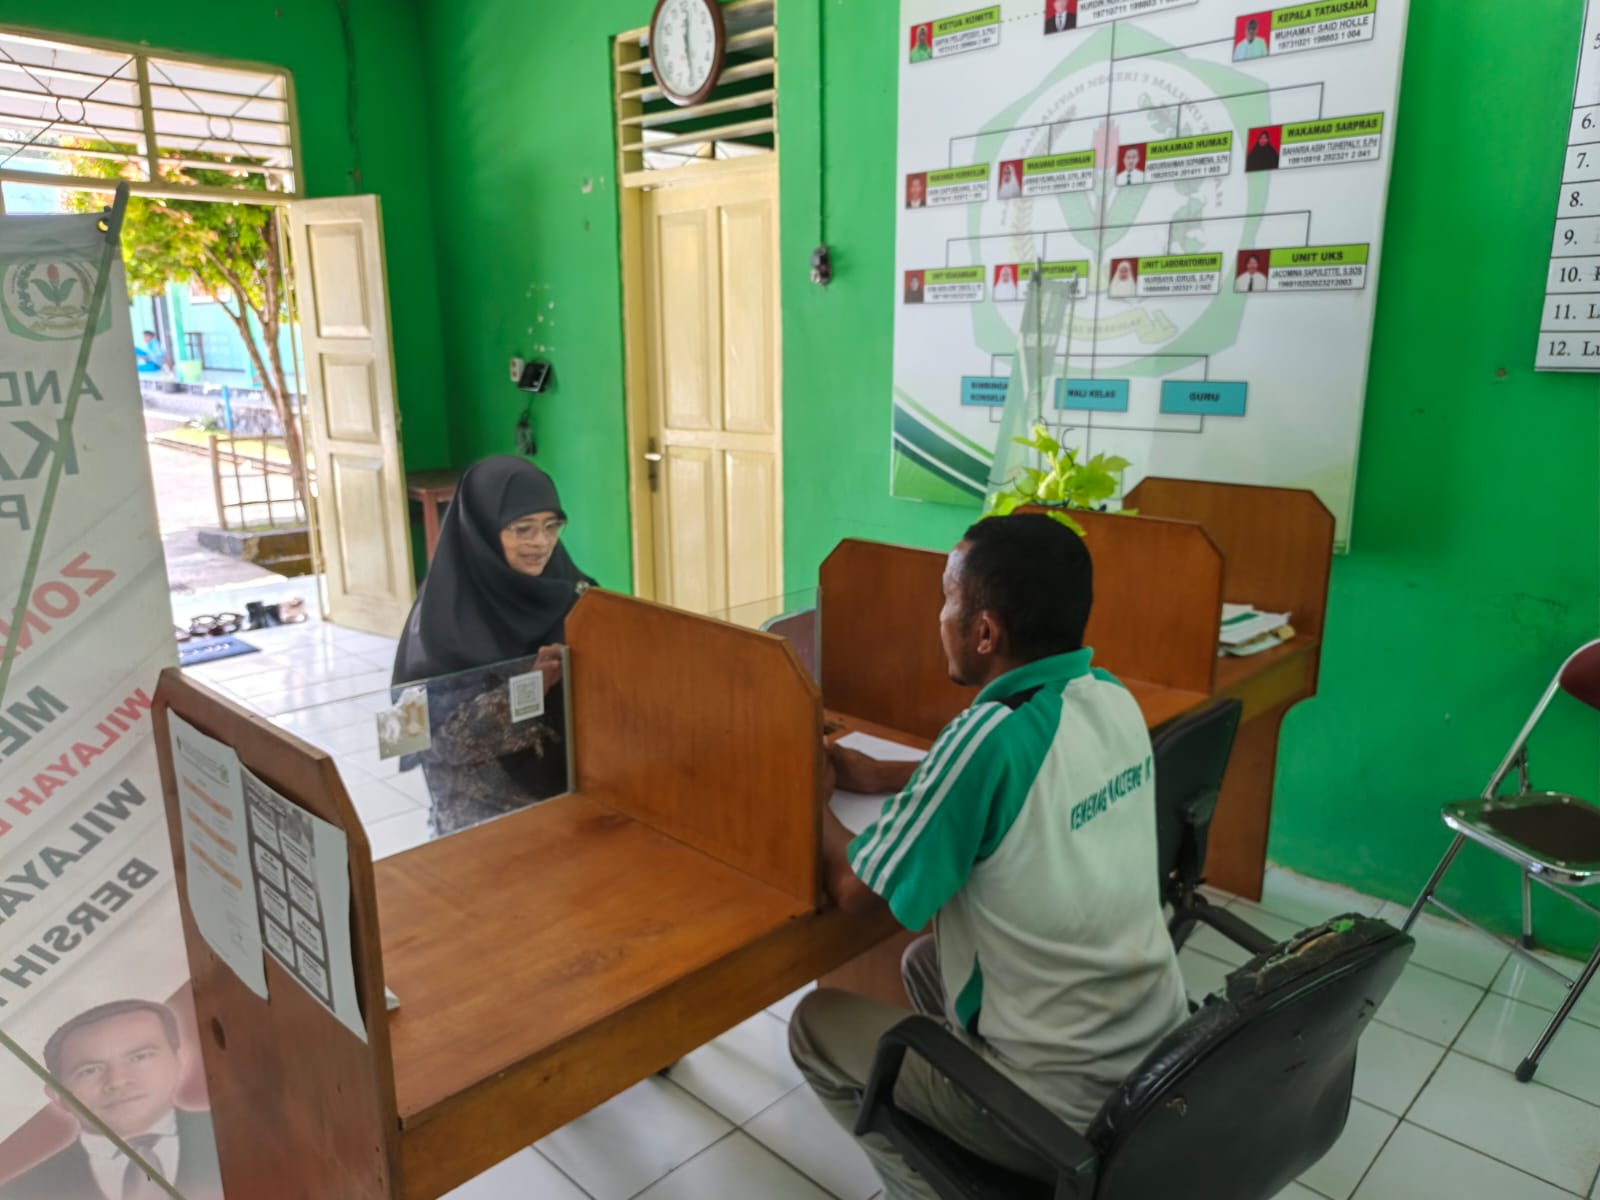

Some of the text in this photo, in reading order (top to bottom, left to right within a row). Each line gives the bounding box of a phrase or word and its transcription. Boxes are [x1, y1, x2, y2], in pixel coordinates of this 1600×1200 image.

[1278, 0, 1368, 24] KEPALA TATAUSAHA
[1275, 16, 1369, 41] MUHAMAT SAID HOLLE
[1287, 118, 1378, 138] WAKAMAD SARPRAS
[1581, 112, 1596, 129] 6.
[1196, 137, 1229, 149] HUMAS
[1576, 152, 1590, 169] 7.
[1569, 191, 1584, 208] 8.
[1564, 229, 1577, 245] 9.
[1291, 250, 1344, 263] UNIT UKS
[1560, 266, 1582, 283] 10.
[1554, 303, 1576, 320] 11.
[1549, 340, 1571, 356] 12.
[1067, 388, 1116, 399] WALI KELAS
[1189, 392, 1220, 403] GURU
